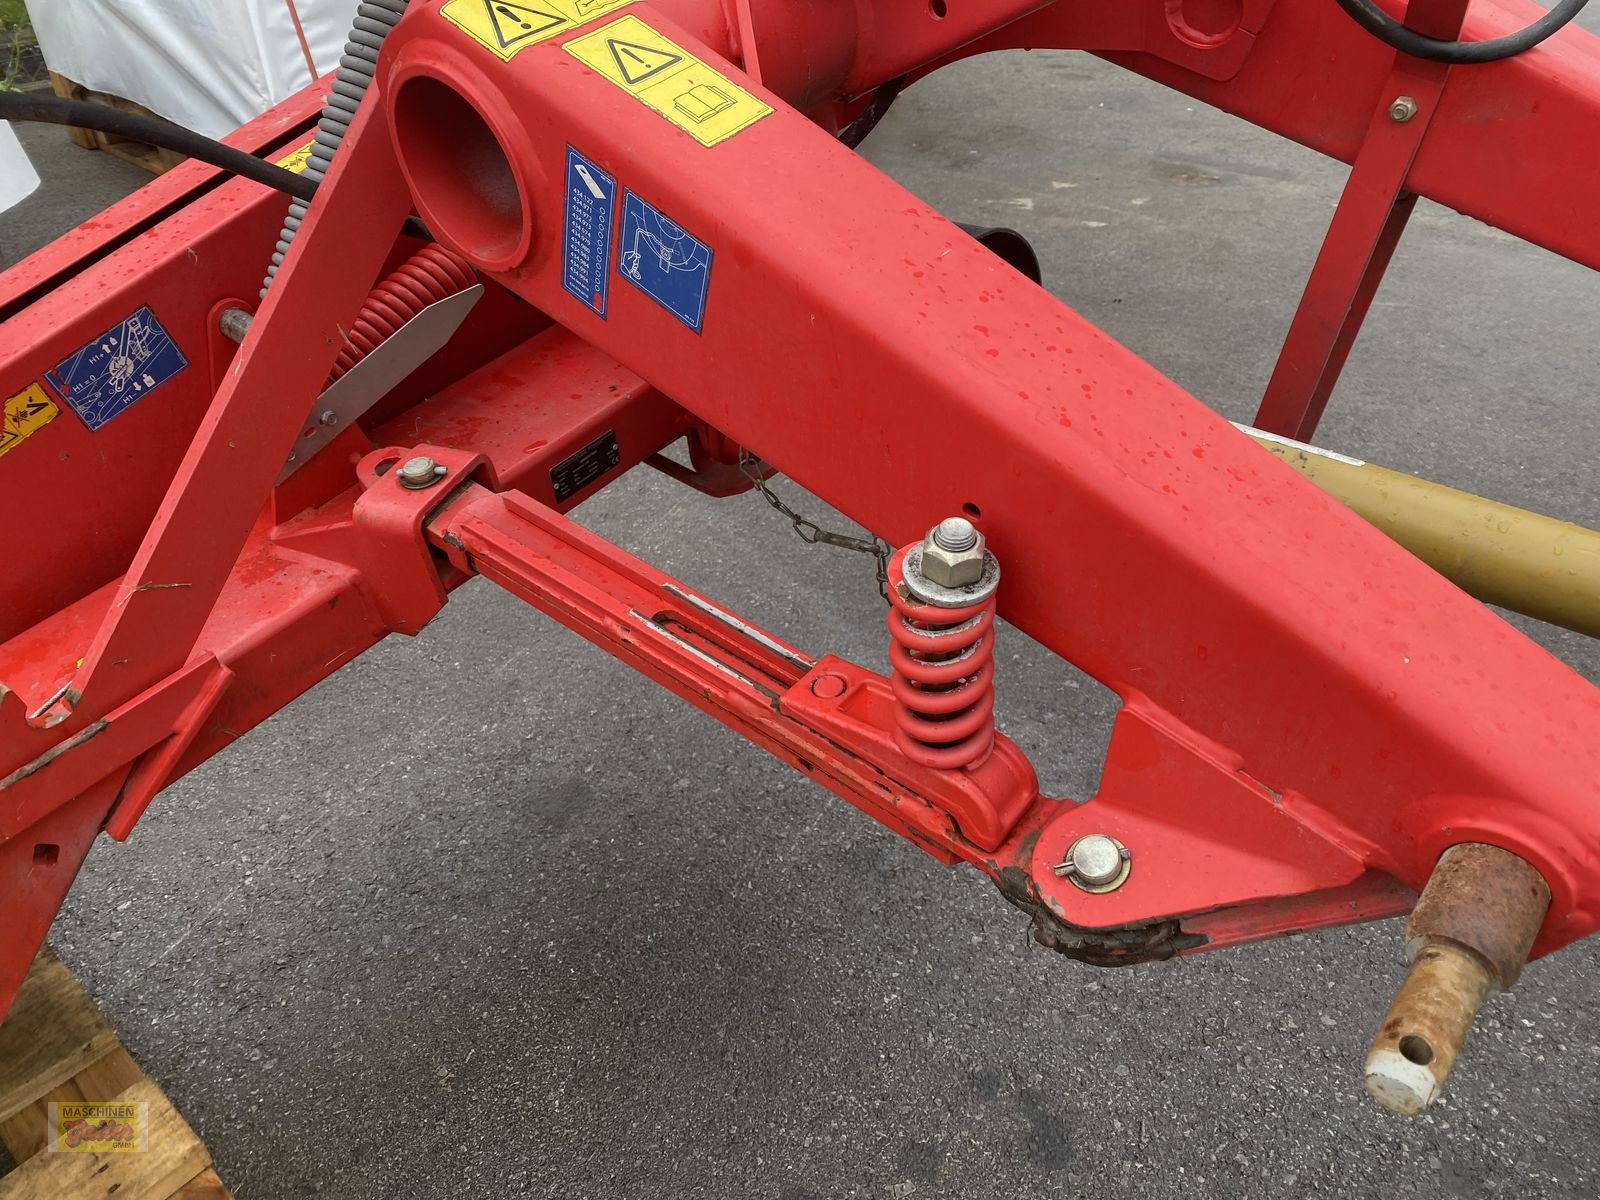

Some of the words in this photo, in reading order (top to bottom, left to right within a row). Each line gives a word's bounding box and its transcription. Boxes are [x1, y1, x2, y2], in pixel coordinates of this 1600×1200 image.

[573, 188, 593, 205] 434.122
[88, 354, 104, 364] H1+
[72, 384, 84, 392] H1
